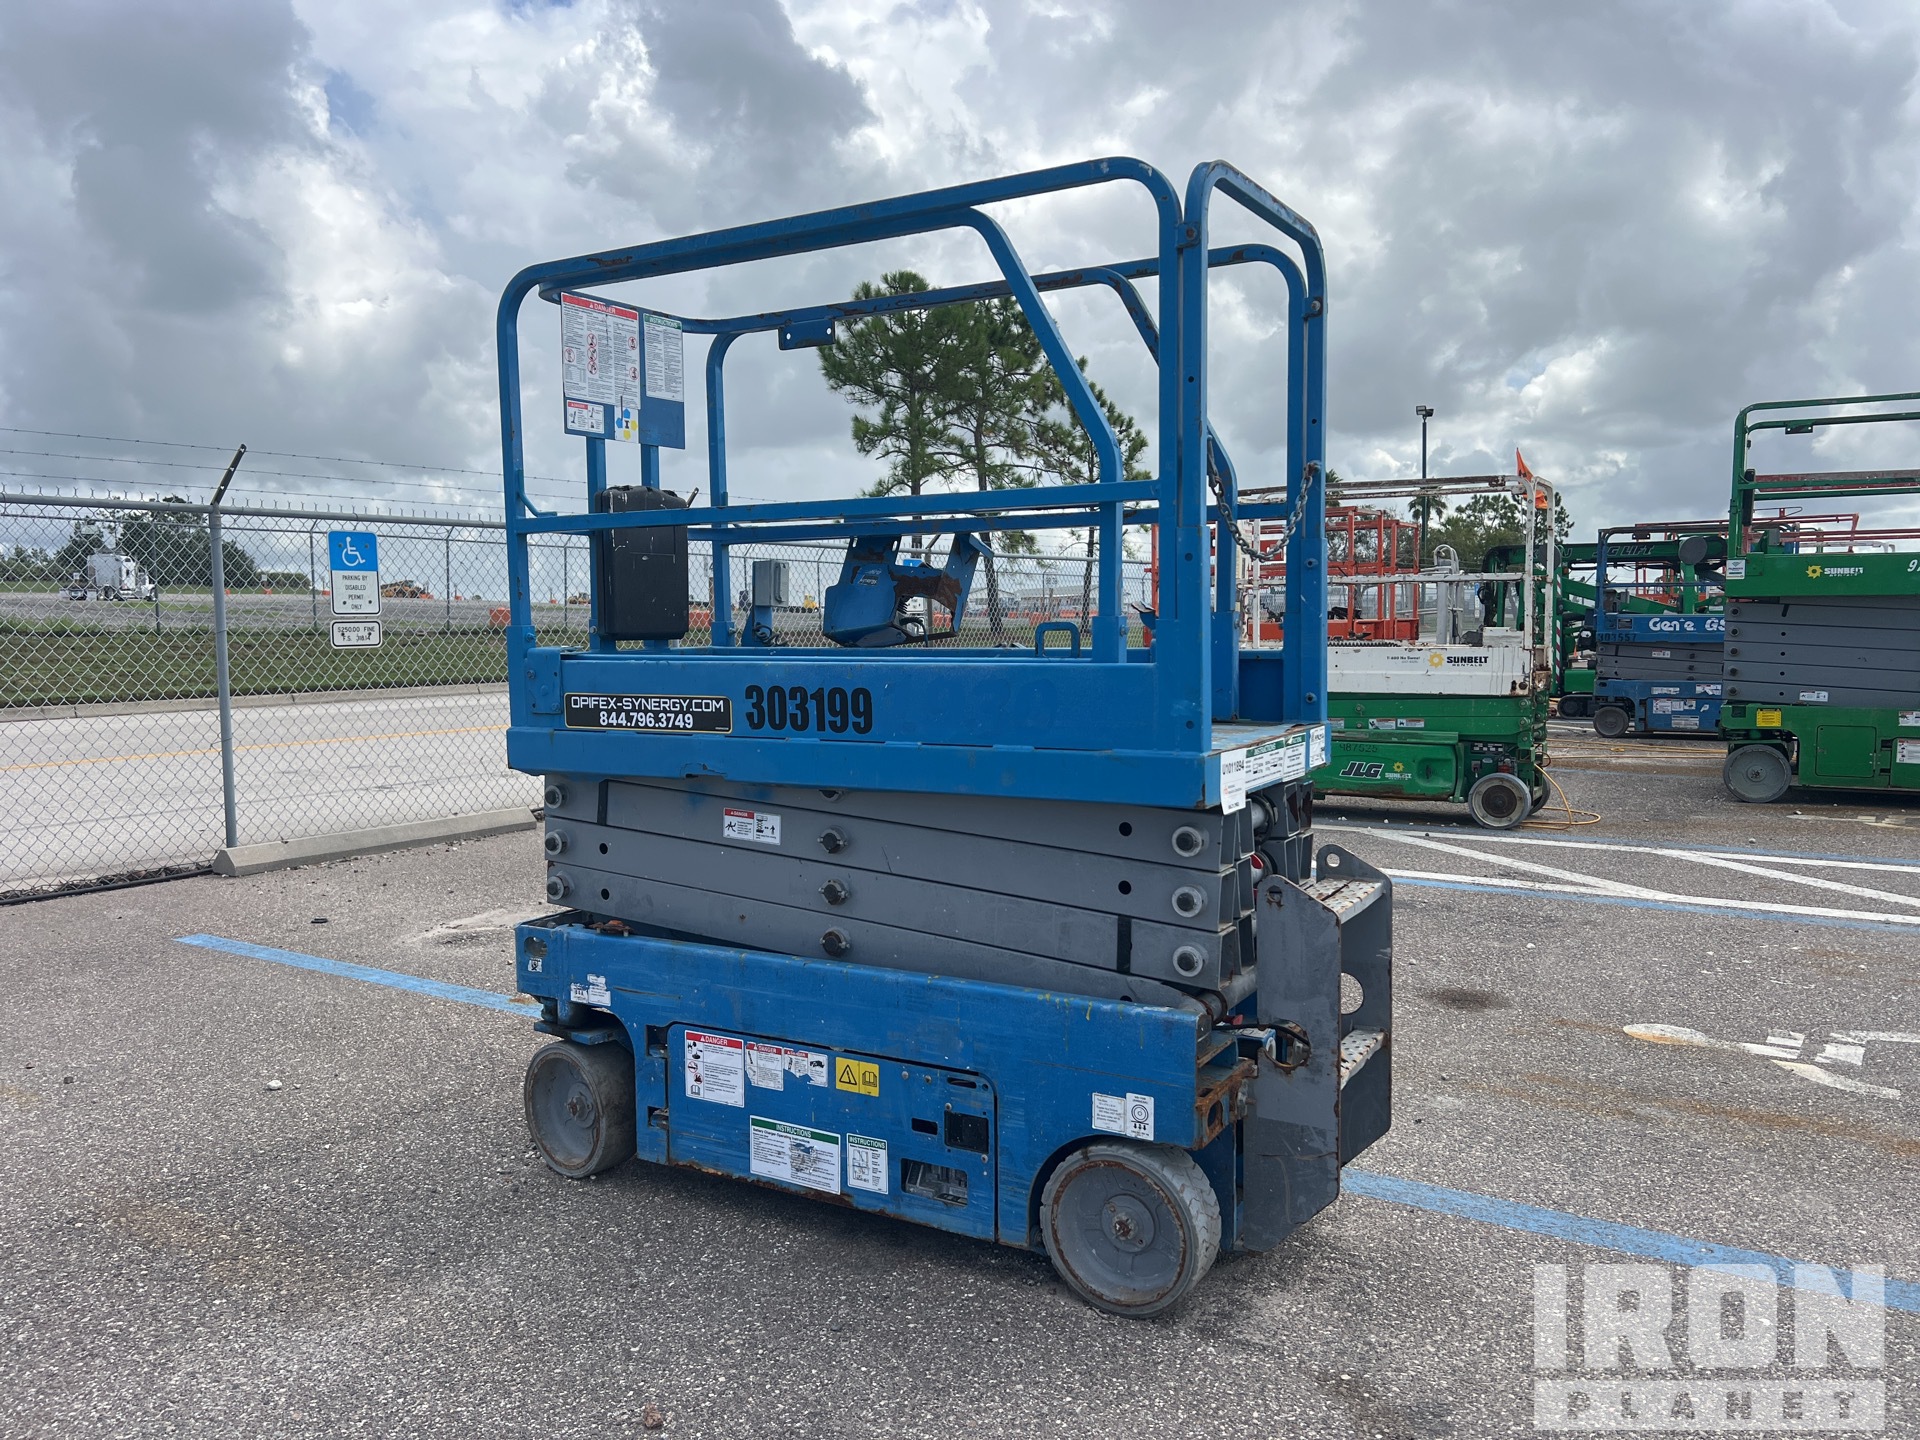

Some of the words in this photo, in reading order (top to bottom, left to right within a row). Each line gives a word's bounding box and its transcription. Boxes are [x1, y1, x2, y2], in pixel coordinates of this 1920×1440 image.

[1620, 545, 1655, 556] LIFT
[1446, 656, 1489, 664] SUNBELT
[571, 696, 724, 713] OPIFEX-SYNERGY.COM
[745, 684, 873, 734] 303199
[599, 710, 694, 728] 844.796.3749
[1339, 761, 1384, 779] JLG
[705, 1036, 728, 1046] DANGER
[759, 1045, 777, 1054] DANGER
[776, 1124, 812, 1138] INSTRUCTIONS
[849, 1136, 886, 1149] INSTRUCTIONS
